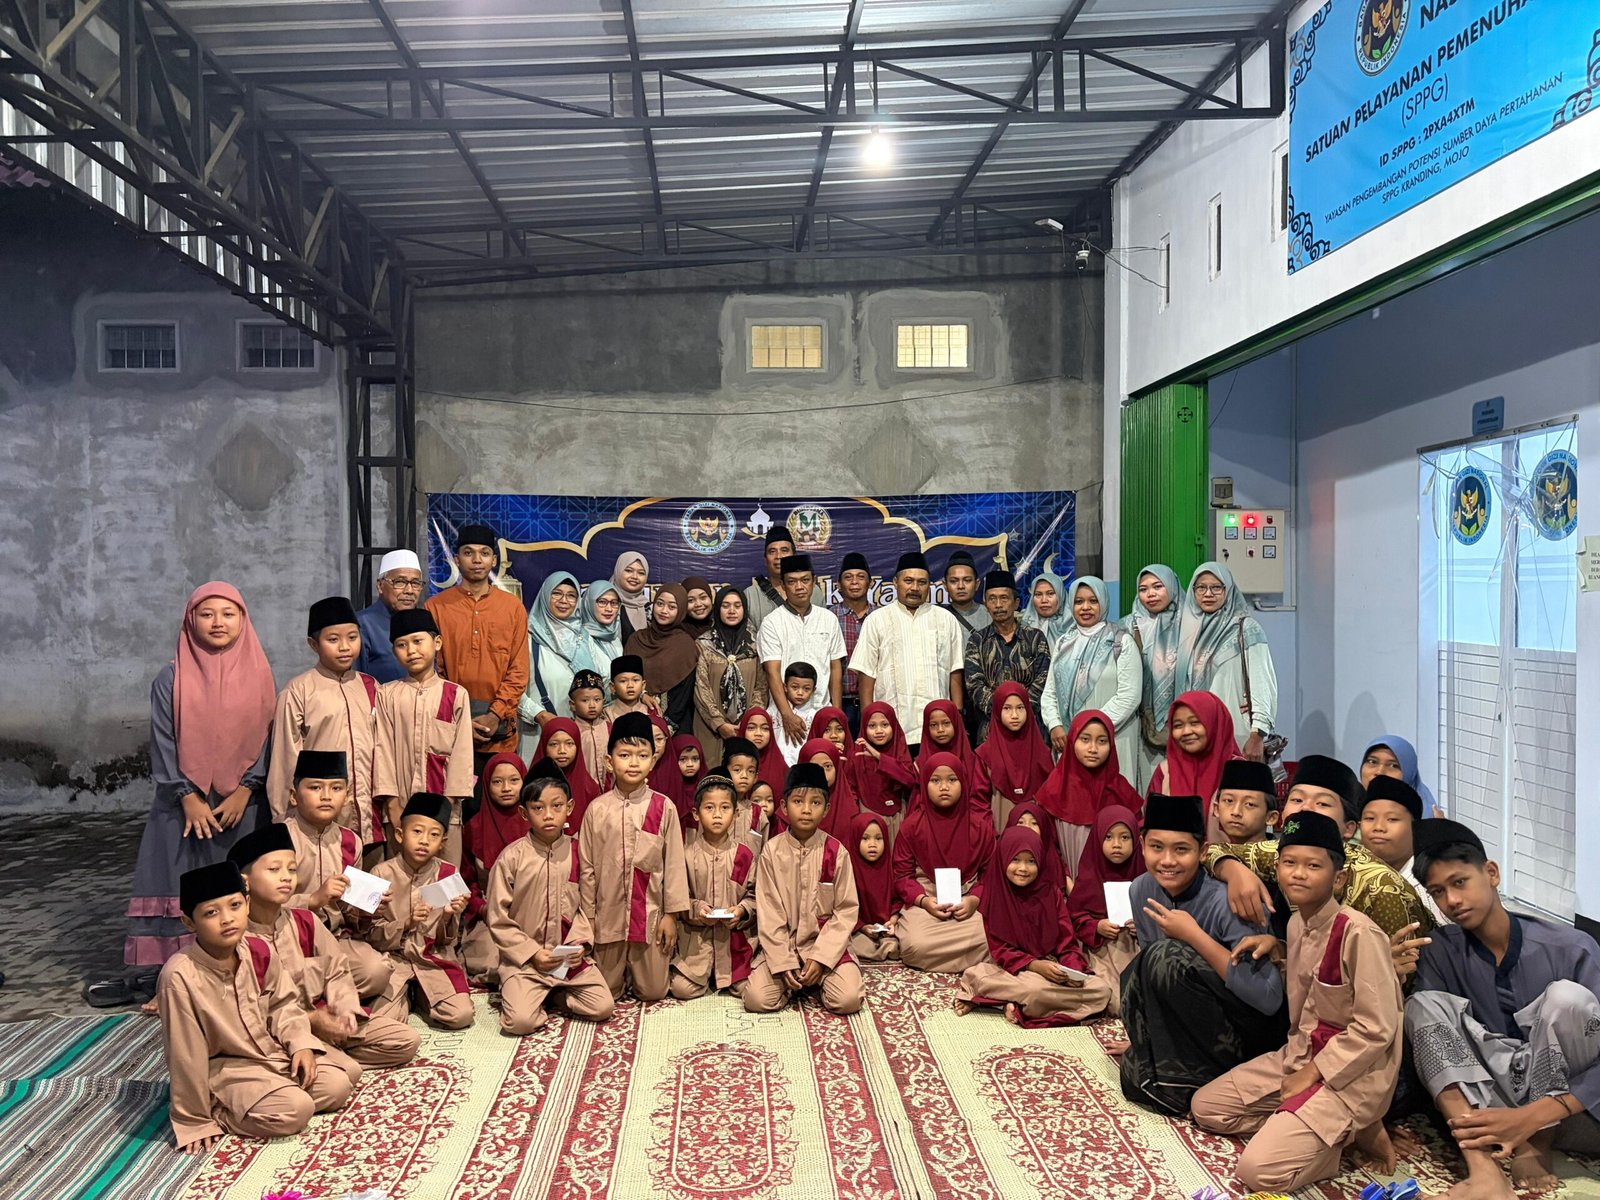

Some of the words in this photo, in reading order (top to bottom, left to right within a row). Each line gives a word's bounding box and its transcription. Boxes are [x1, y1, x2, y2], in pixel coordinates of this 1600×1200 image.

[1420, 0, 1457, 29] NA
[1305, 116, 1351, 163] SATUAN
[1354, 54, 1432, 128] PELAYANAN
[1380, 152, 1389, 168] ID
[1391, 136, 1416, 160] SPPG
[1423, 97, 1475, 141] 2PXA4XTM
[1401, 72, 1449, 129] (SPPG)
[1325, 201, 1351, 224] YAYASAN
[1352, 166, 1407, 207] PENGEMBANGAN
[1408, 146, 1441, 173] POTENSI
[1442, 126, 1475, 154] SUMBER
[1475, 112, 1498, 134] DAYA
[1500, 71, 1563, 119] PERTAHANAN
[1382, 186, 1400, 204] SPPG
[1400, 162, 1442, 193] KRANDING,
[1444, 145, 1469, 169] MOJO
